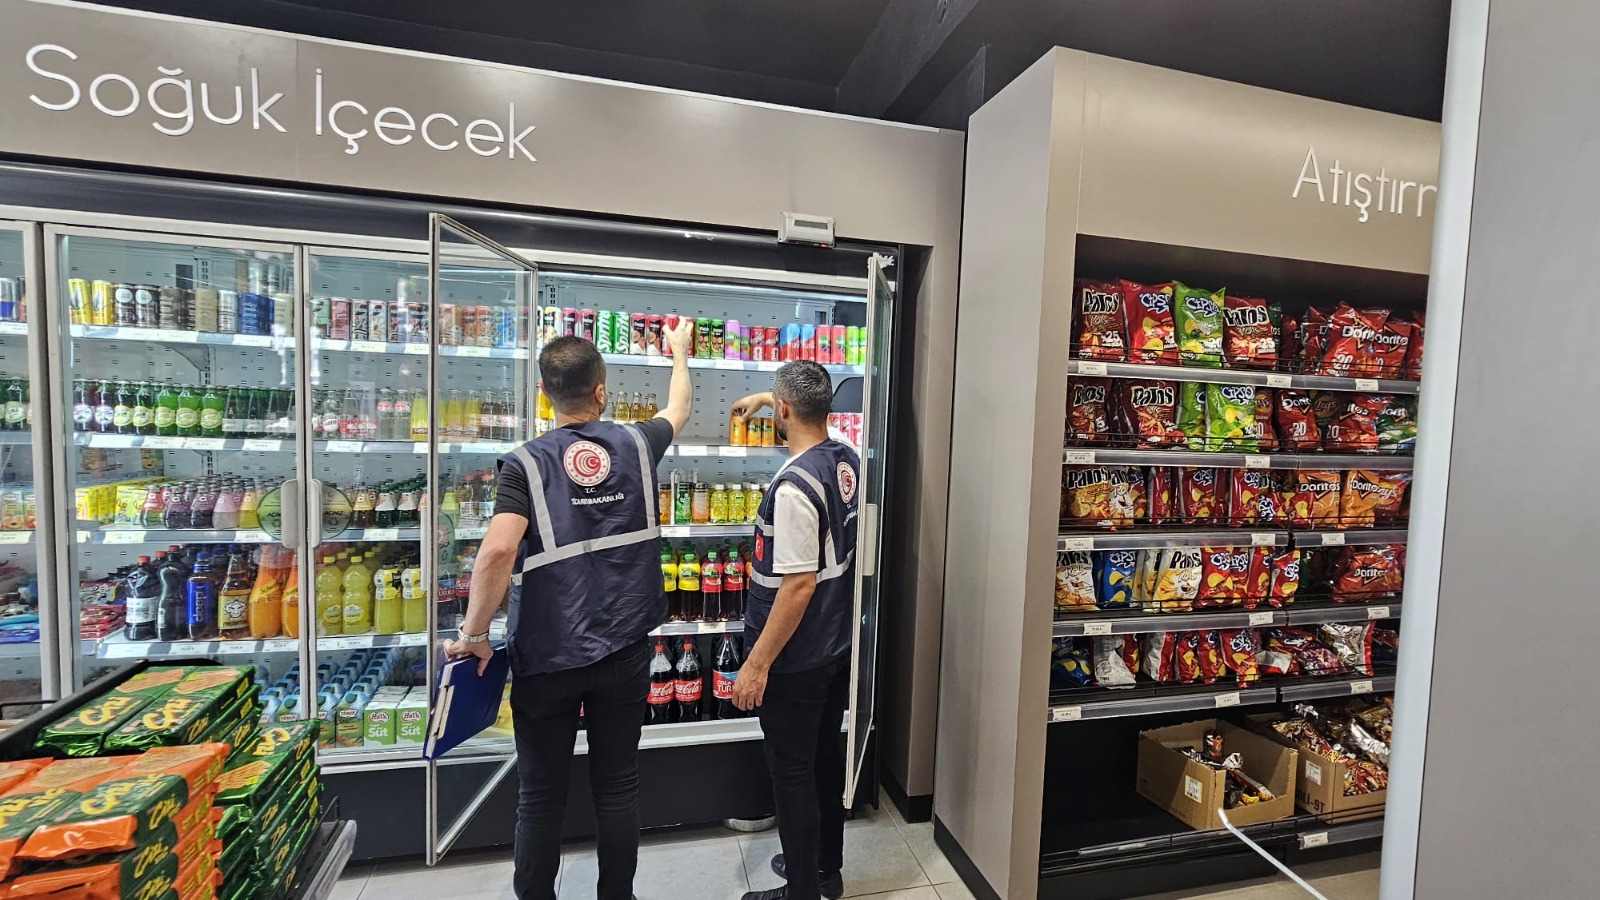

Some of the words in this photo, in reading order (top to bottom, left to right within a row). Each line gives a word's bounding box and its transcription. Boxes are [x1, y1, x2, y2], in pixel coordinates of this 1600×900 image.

[25, 43, 287, 137] Soğuk
[314, 67, 538, 163] İçecek
[1300, 482, 1340, 493] Doritos
[718, 684, 734, 693] TUR
[371, 711, 387, 721] Halk
[403, 711, 421, 720] Halk
[368, 726, 388, 737] Süt
[401, 725, 421, 736] Süt
